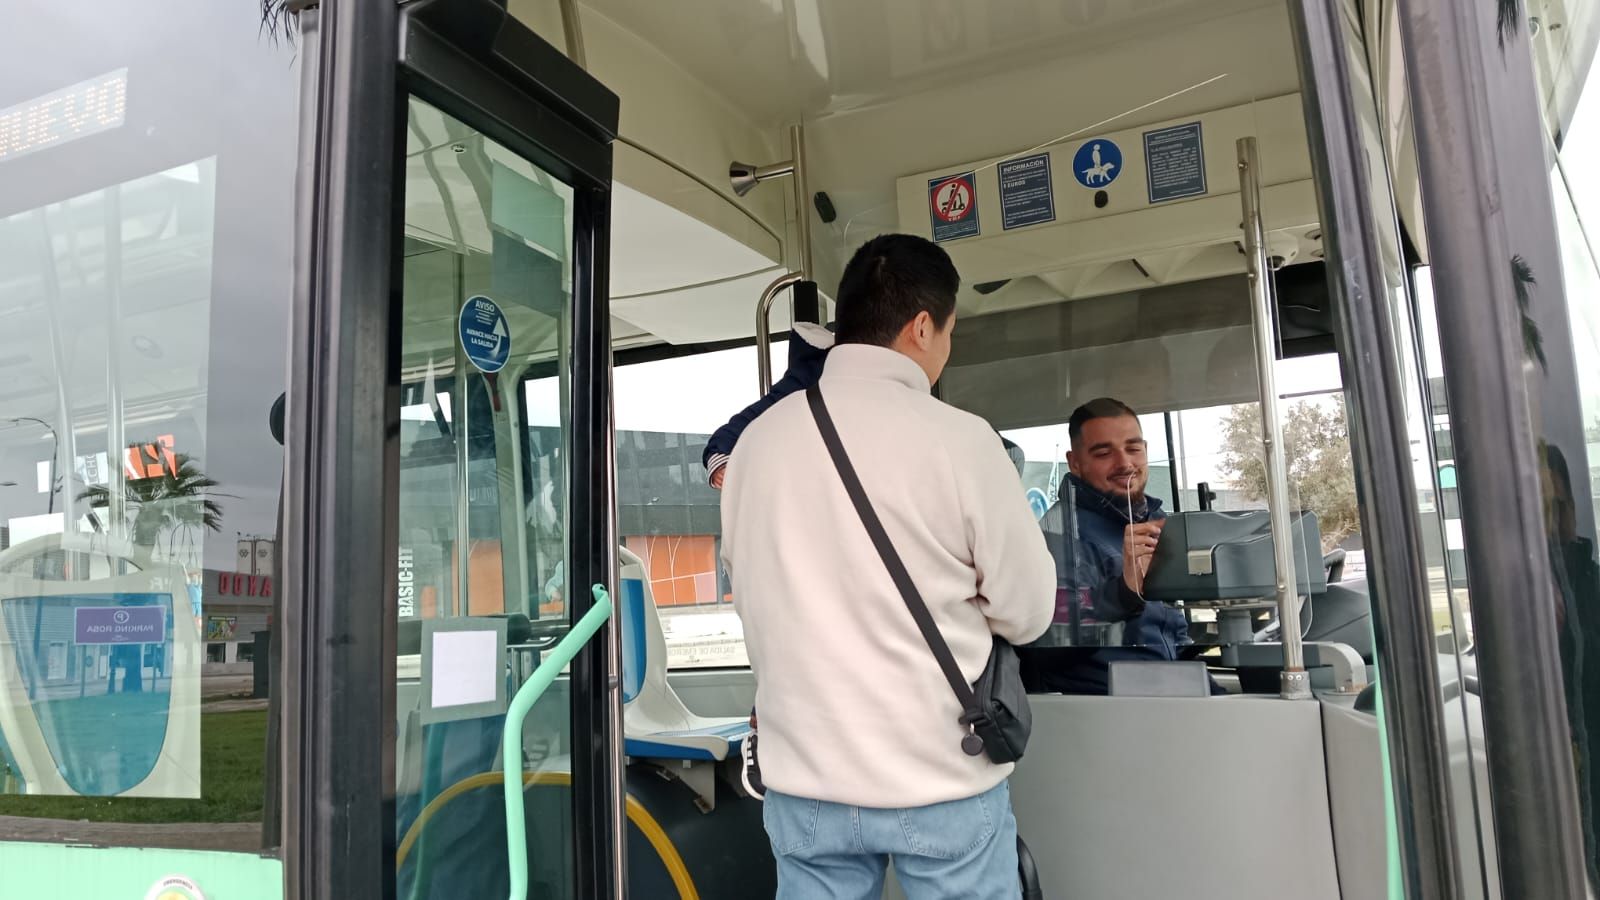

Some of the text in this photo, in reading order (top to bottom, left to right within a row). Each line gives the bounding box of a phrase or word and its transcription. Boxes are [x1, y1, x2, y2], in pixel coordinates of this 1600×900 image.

[475, 300, 495, 312] AVISO
[471, 337, 494, 348] LA SALIDA
[398, 546, 414, 617] BASIC-FIT
